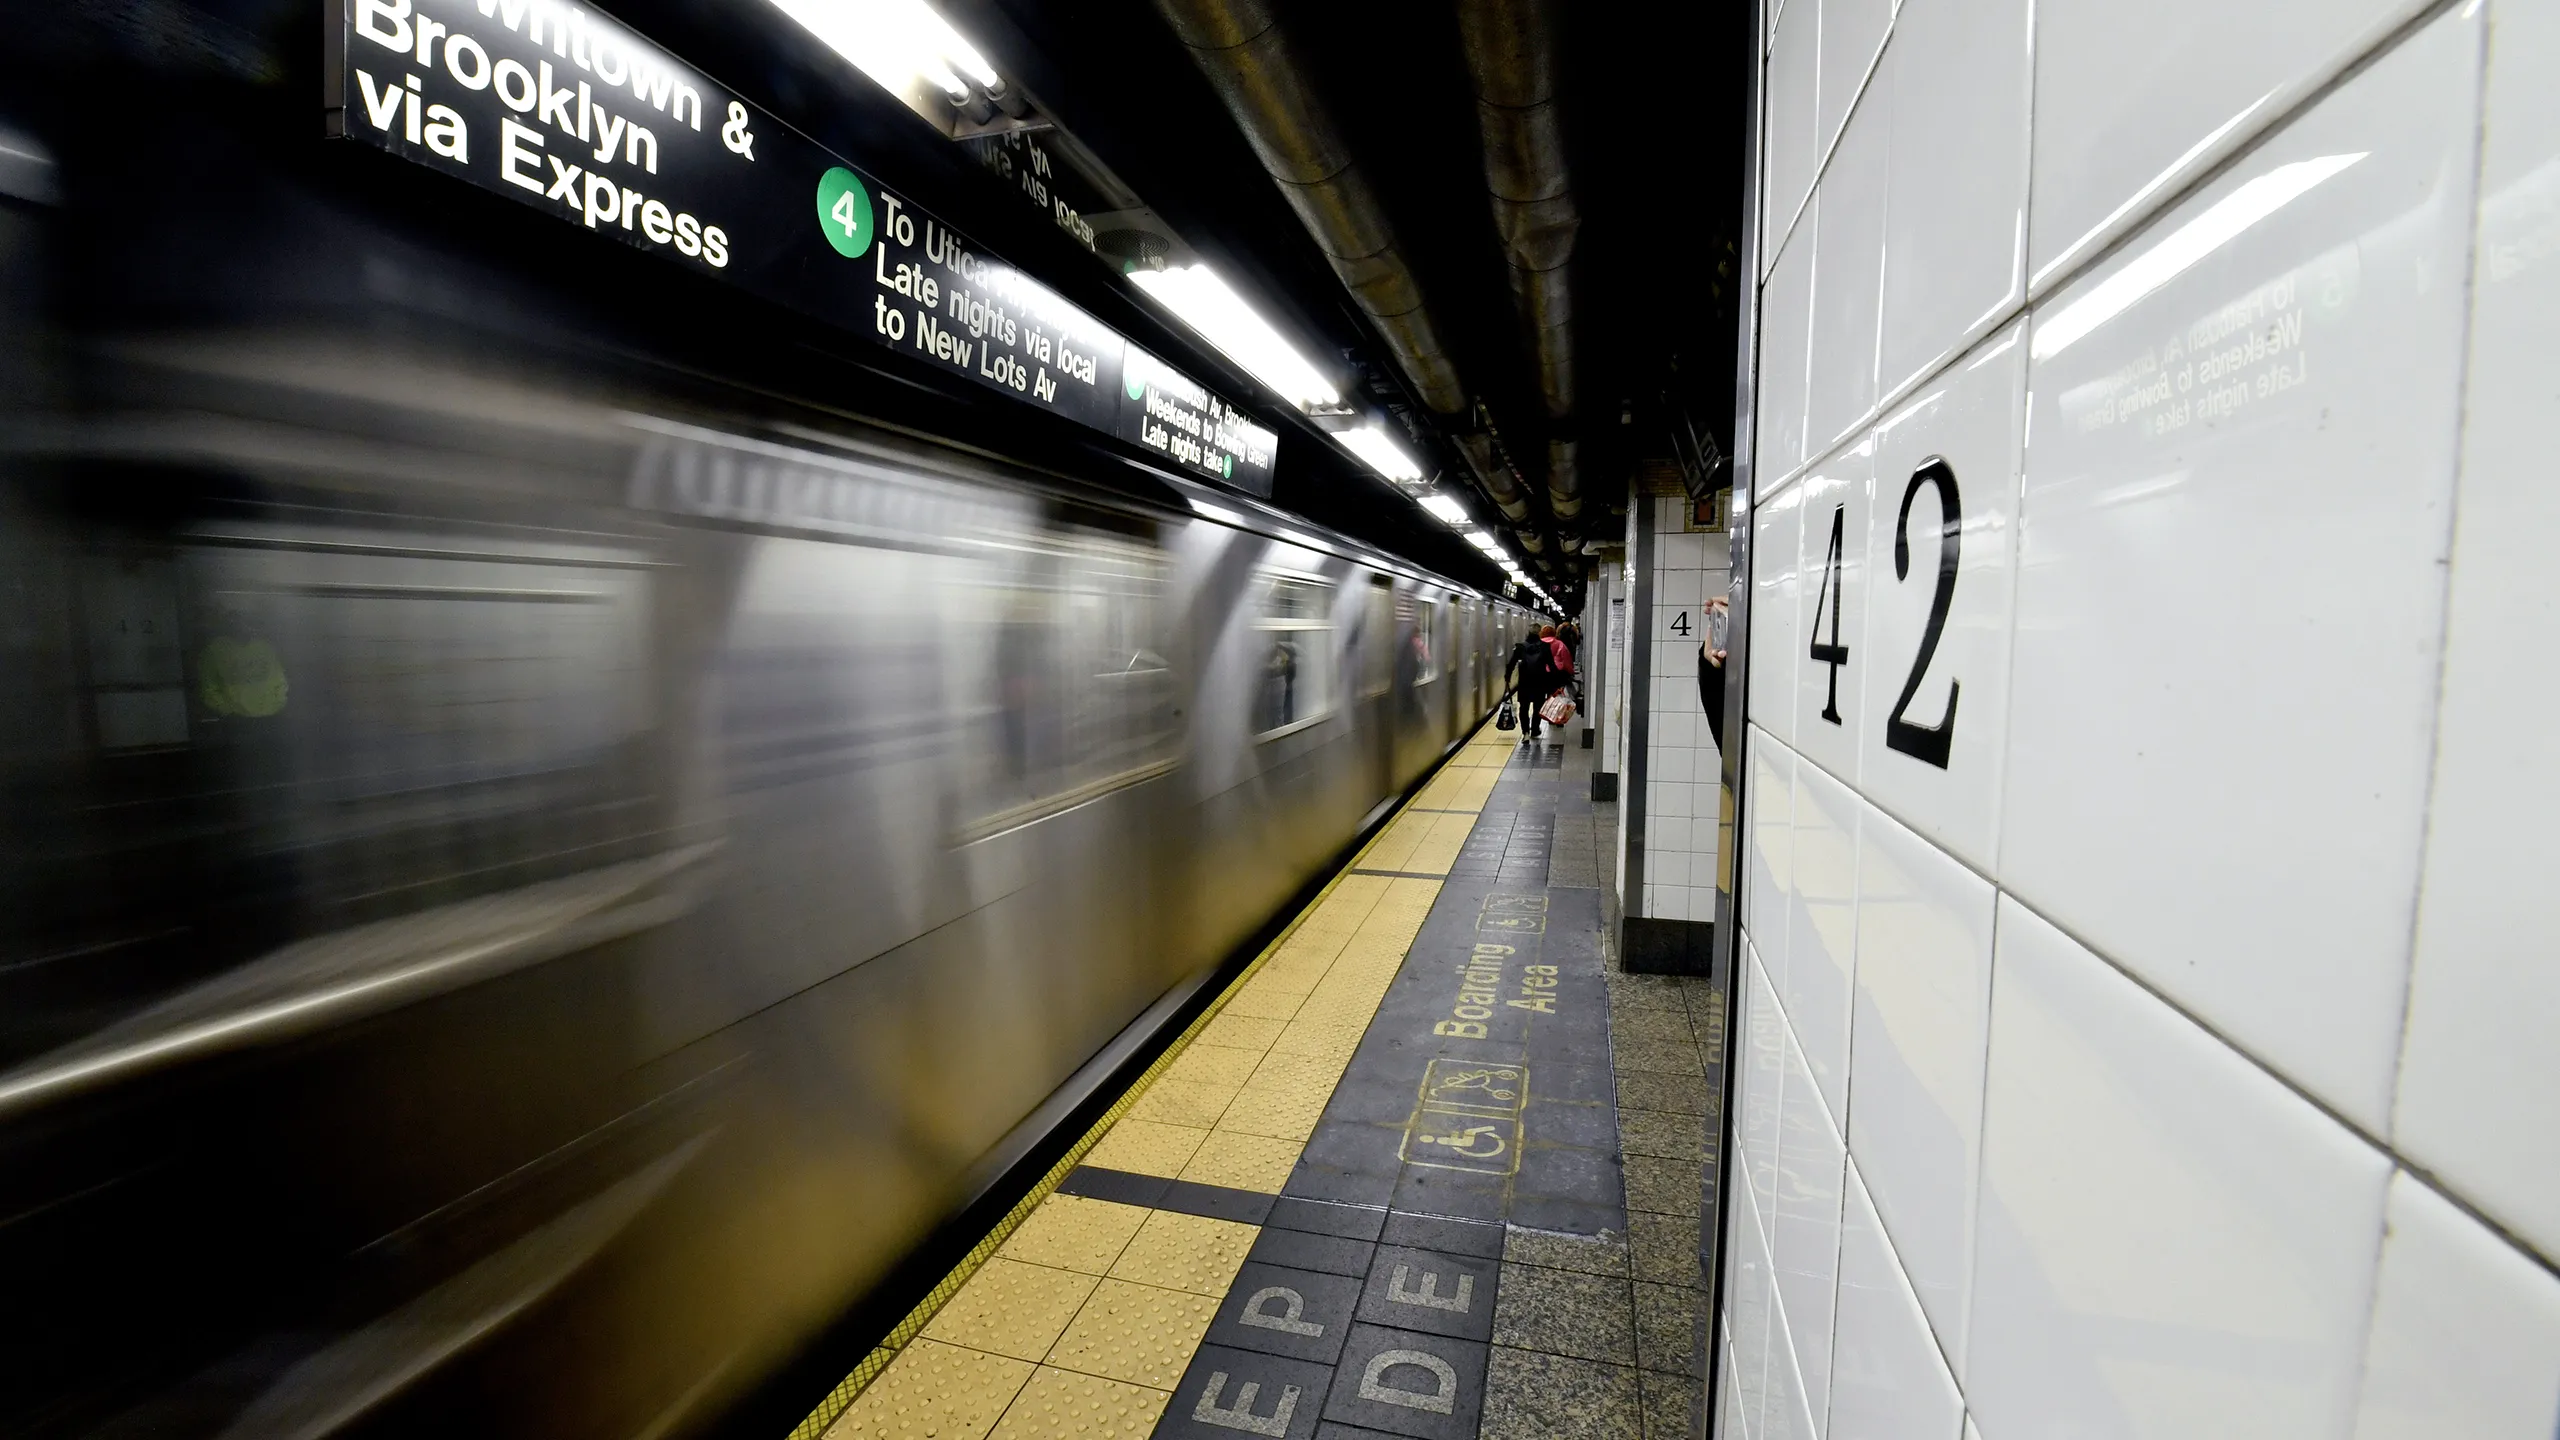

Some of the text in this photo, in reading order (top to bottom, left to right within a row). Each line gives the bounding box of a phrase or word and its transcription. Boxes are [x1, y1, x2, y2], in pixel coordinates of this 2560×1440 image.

[355, 0, 658, 175] Brooklyn
[721, 100, 755, 162] &
[355, 68, 730, 269] via Express
[831, 190, 857, 238] 4
[881, 192, 990, 290] To Utica
[875, 294, 1058, 404] to New Lots Av
[876, 242, 938, 309] Late
[949, 284, 1016, 347] nights
[1024, 321, 1051, 364] via
[1057, 343, 1096, 386] local
[1141, 415, 1168, 451] Late
[1170, 432, 1201, 464] nights
[1203, 445, 1223, 473] take
[1145, 385, 1201, 437] Weekends
[1203, 418, 1213, 442] to
[1214, 423, 1246, 463] Bowling
[1670, 611, 1692, 637] 4
[1810, 453, 1962, 771] 42
[1433, 941, 1516, 1041] Boarding
[1505, 963, 1558, 1016] Area
